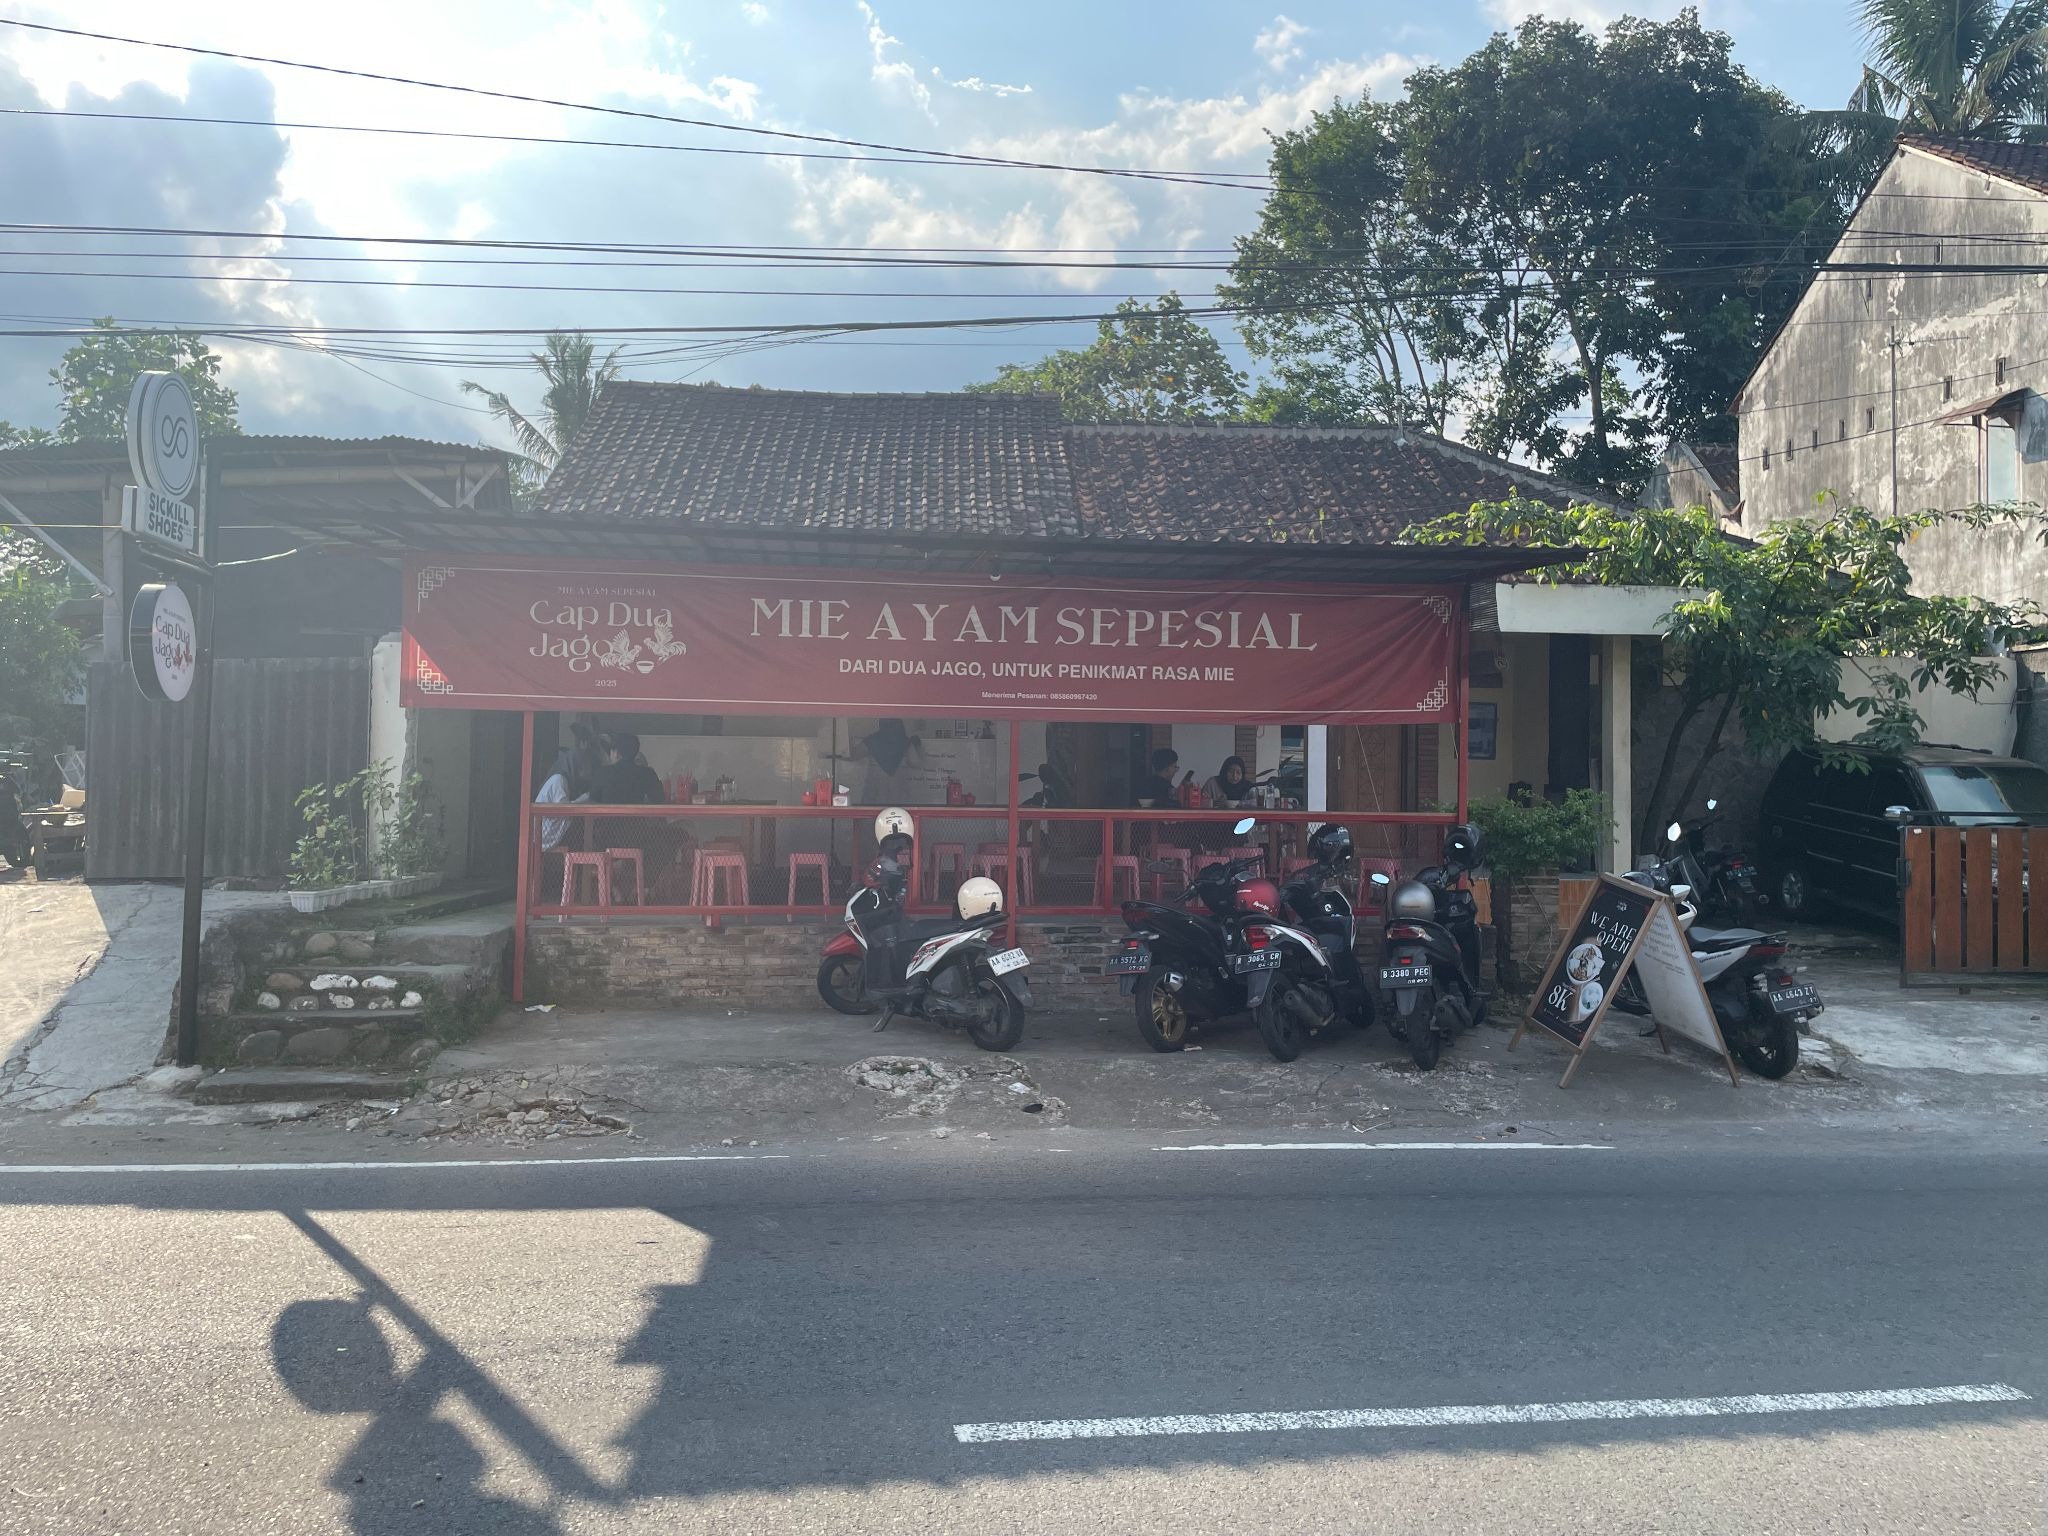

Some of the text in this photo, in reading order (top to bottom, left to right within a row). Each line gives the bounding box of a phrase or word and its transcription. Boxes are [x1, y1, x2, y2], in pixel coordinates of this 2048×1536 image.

[149, 492, 189, 526] SICKILL
[148, 511, 184, 542] SHOES
[155, 615, 174, 640] Cap
[175, 623, 191, 643] Dua
[529, 600, 674, 631] Cap Dua
[750, 598, 1318, 651] MIE AYAM SEPESIAL
[529, 632, 615, 673] Jago
[839, 658, 1235, 682] DARI DUA JAGO, UNTUK PENIKMAT RASA MIE
[981, 691, 1016, 699] Menerima
[1017, 692, 1049, 700] Pesanan:
[1590, 911, 1610, 930] WE
[1609, 921, 1637, 942] ARE
[1596, 930, 1631, 955] OPEN
[1548, 984, 1574, 1012] 8K
